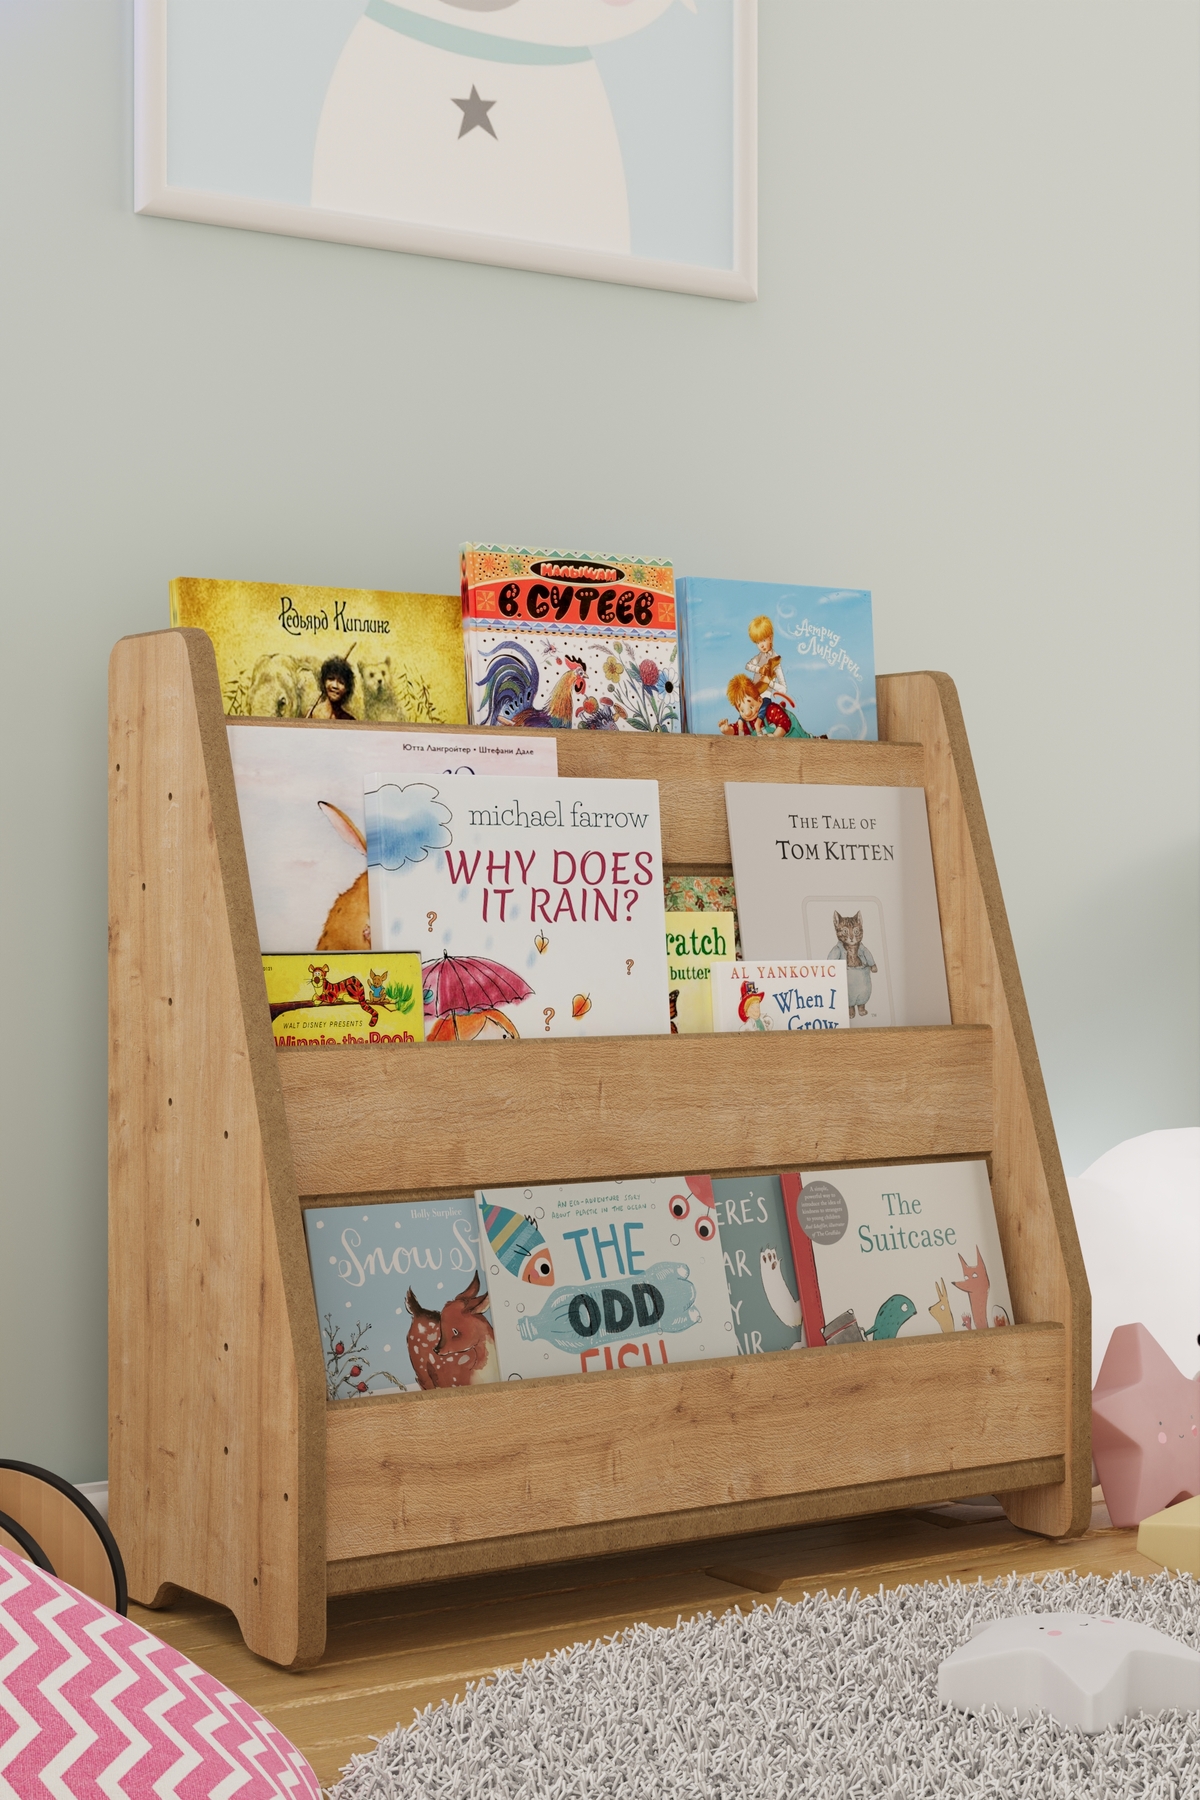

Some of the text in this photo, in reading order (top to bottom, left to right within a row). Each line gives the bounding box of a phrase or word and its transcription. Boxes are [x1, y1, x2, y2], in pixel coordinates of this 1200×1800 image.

[540, 563, 617, 582] МАЛЫШАМ
[278, 596, 391, 636] Редьярд Киплинг
[498, 582, 655, 626] В. СУТЕЕВ
[794, 618, 840, 648] Астрид
[797, 636, 863, 681] Линдгрен
[402, 743, 535, 756] Ютта Лангройтер Штефани Дале
[468, 799, 649, 828] michael farrow
[445, 849, 653, 886] WHY DOES
[482, 887, 639, 923] IT RAIN?
[665, 927, 727, 956] ratch
[669, 966, 711, 980] butter
[731, 965, 836, 979] AL YANKOVIC
[772, 988, 837, 1014] When I
[303, 1021, 326, 1029] DISNEY
[329, 1020, 363, 1028] PRESENTS
[788, 1015, 839, 1031] Grow
[411, 1207, 462, 1220] Holly Surplice
[552, 1211, 571, 1219] ABOUT
[576, 1208, 598, 1216] PLASTIC
[627, 1203, 647, 1211] OCEAN
[569, 1195, 619, 1208] ECO-ADVENTURE
[881, 1192, 922, 1216] The
[563, 1222, 645, 1281] THE
[858, 1224, 957, 1253] Suitcase
[338, 1228, 443, 1287] Snow
[568, 1283, 665, 1337] ODD
